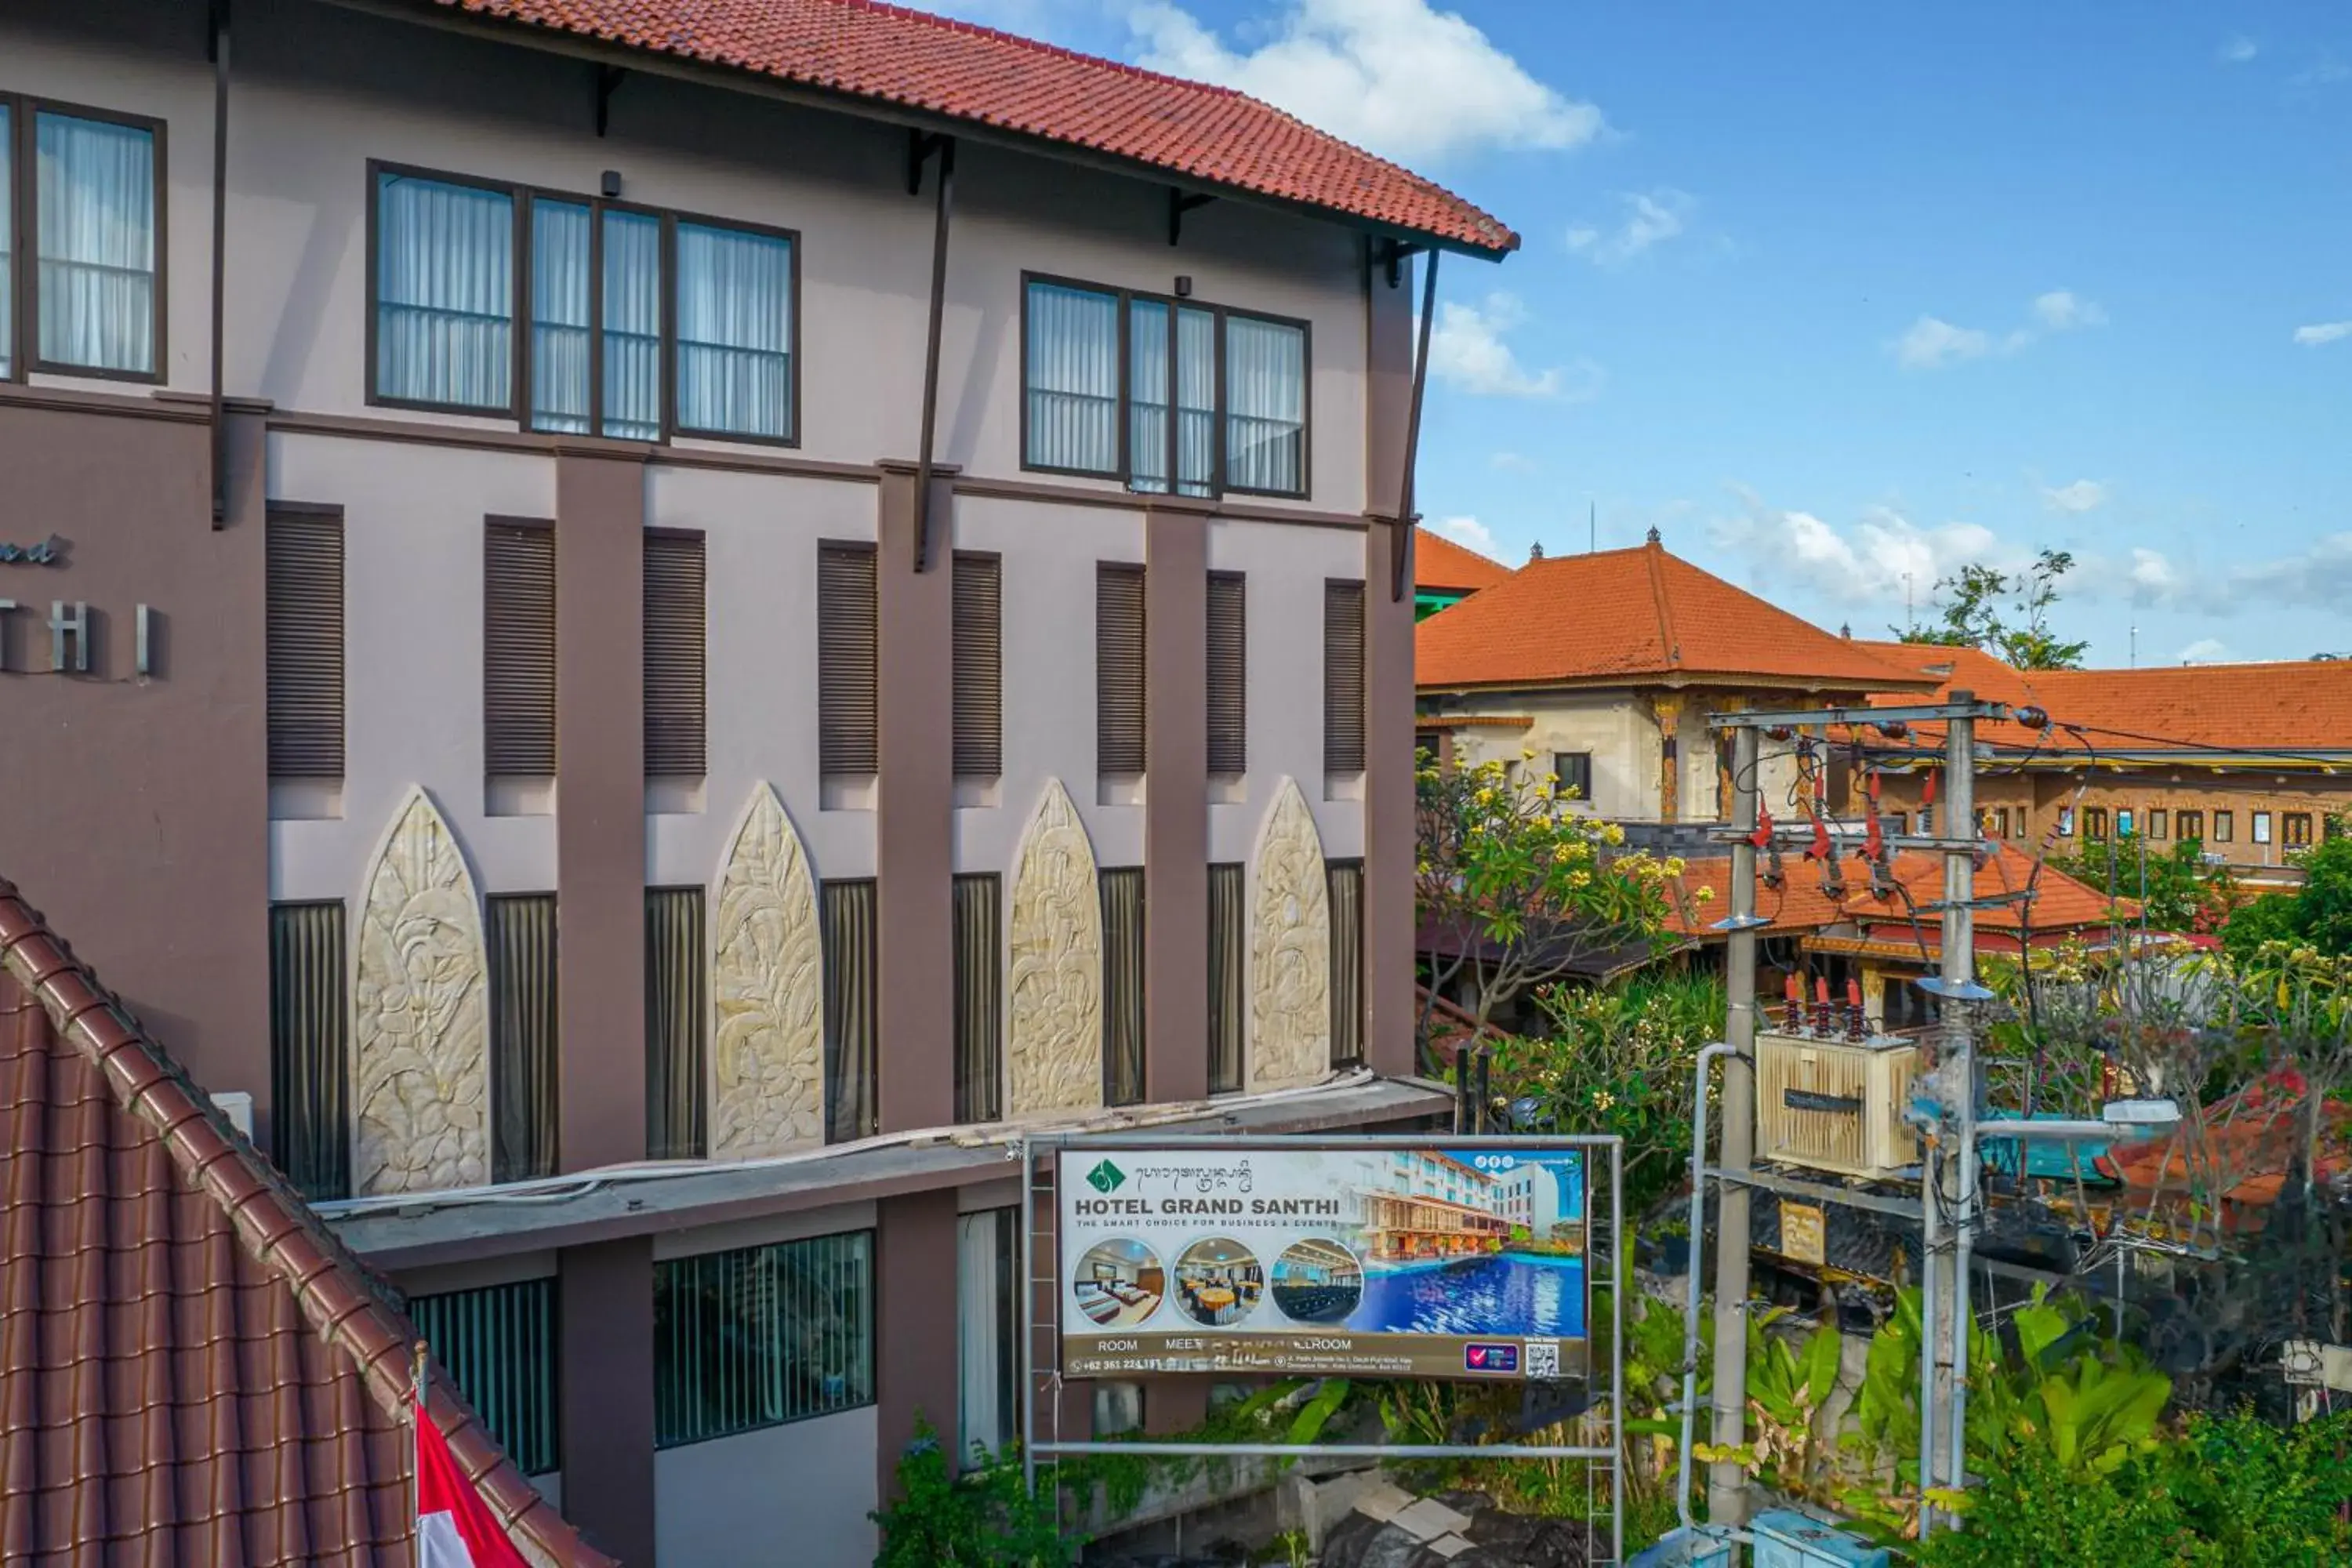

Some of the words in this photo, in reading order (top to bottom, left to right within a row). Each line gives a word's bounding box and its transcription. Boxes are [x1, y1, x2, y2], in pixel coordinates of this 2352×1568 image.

[1075, 1199, 1153, 1215] HOTEL
[1161, 1199, 1243, 1215] GRAND
[1251, 1199, 1340, 1215] SANTHI
[1098, 1340, 1138, 1351] ROOM
